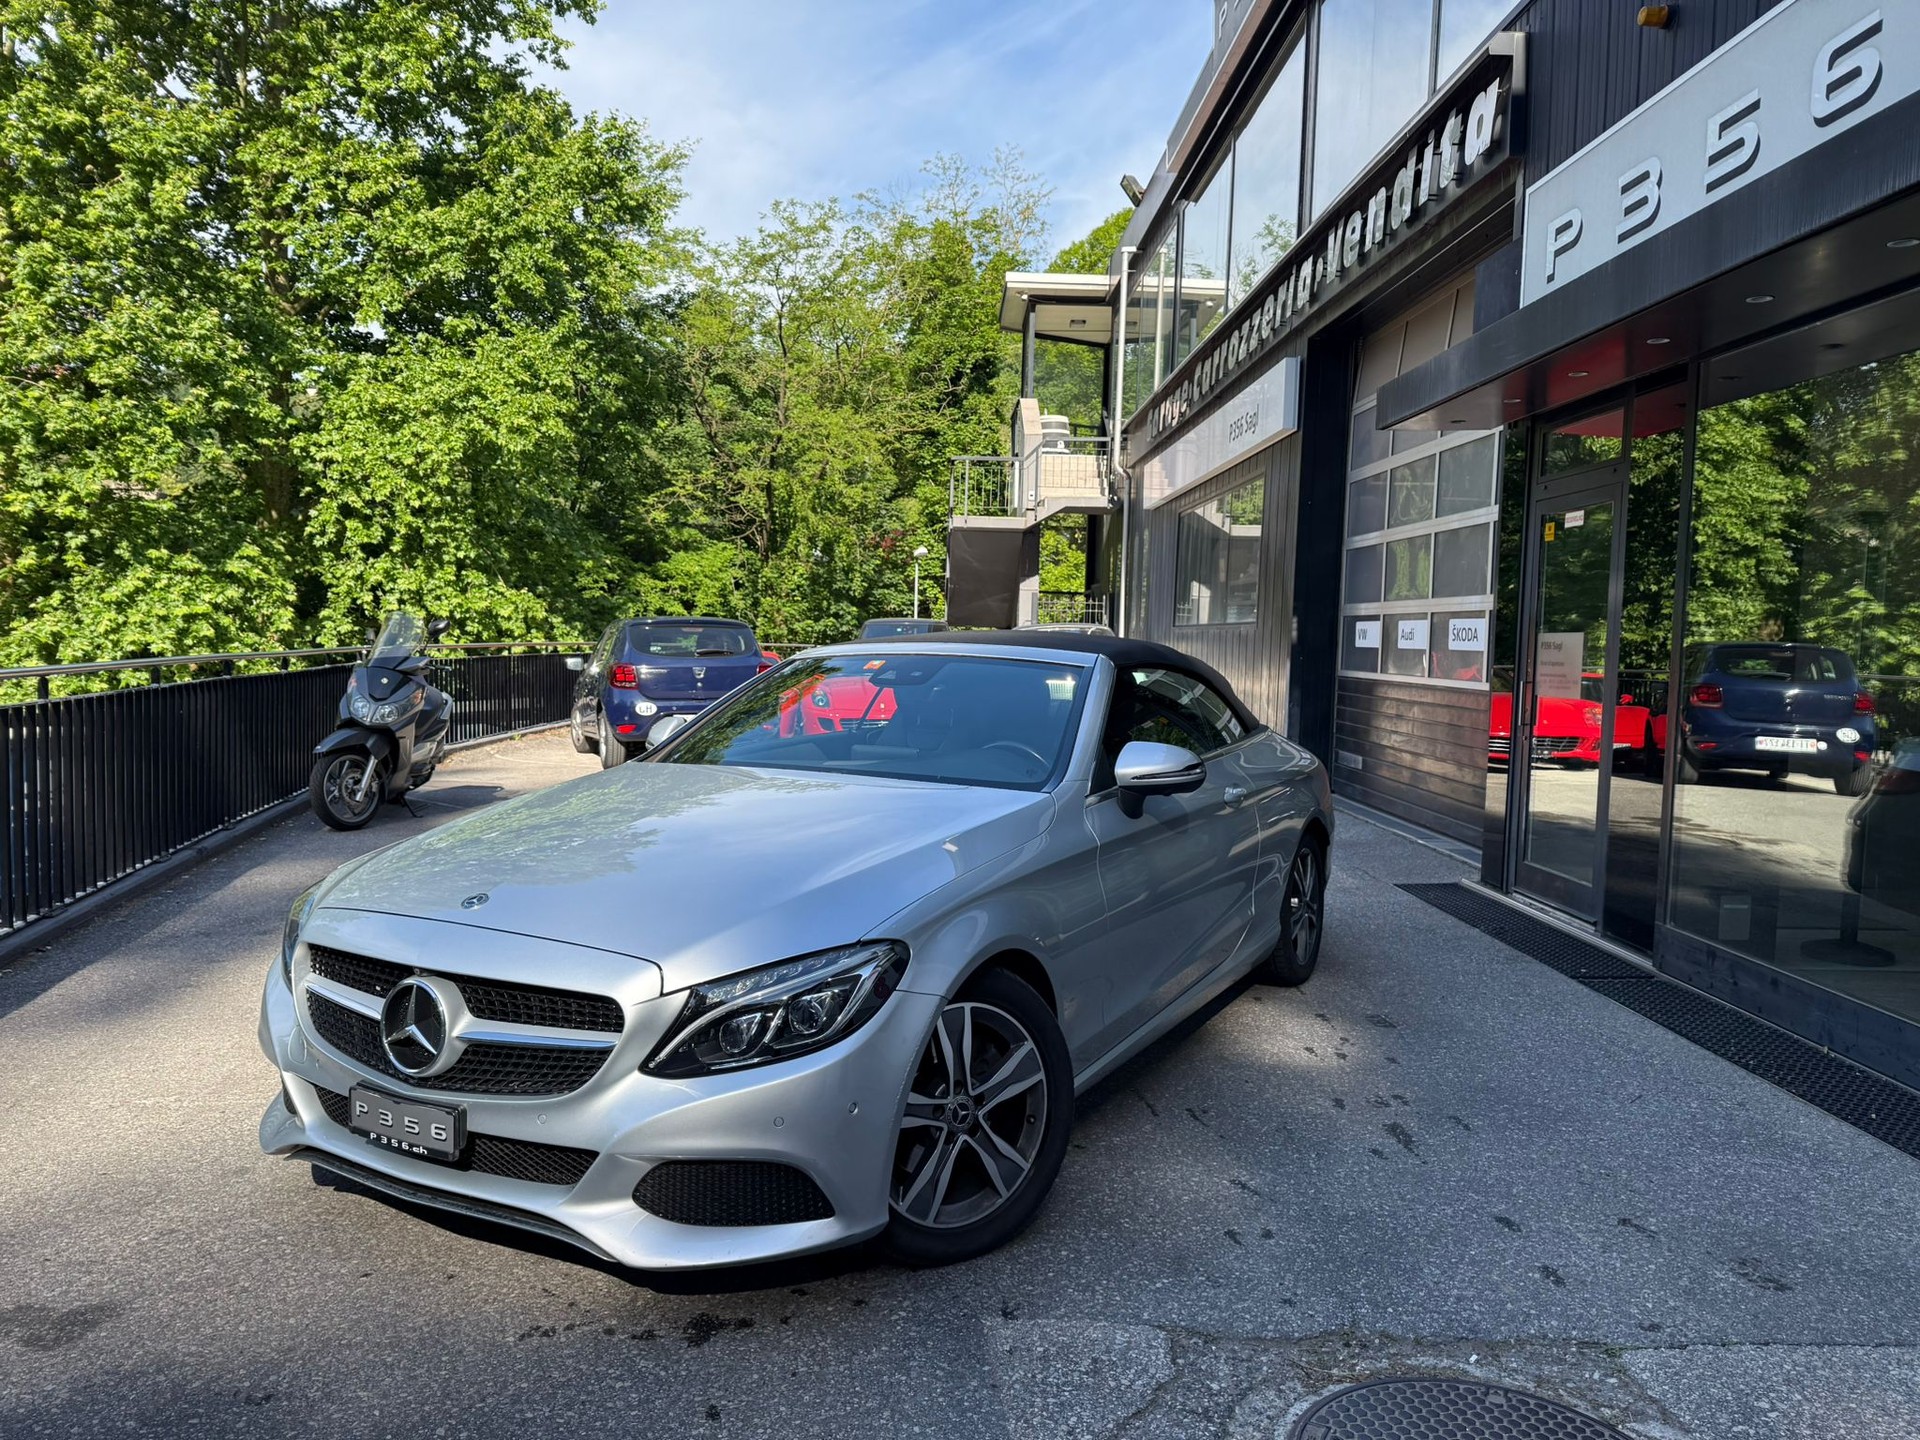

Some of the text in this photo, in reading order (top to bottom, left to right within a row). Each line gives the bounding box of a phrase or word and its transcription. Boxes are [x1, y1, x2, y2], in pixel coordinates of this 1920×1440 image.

[1326, 77, 1500, 285] Vendita
[1228, 403, 1259, 443] P356 Sagl
[1357, 628, 1368, 641] VW
[1400, 628, 1415, 641] Audi
[1452, 624, 1479, 642] ŠKODA
[355, 1101, 447, 1141] P356
[370, 1132, 428, 1155] P356.ch
